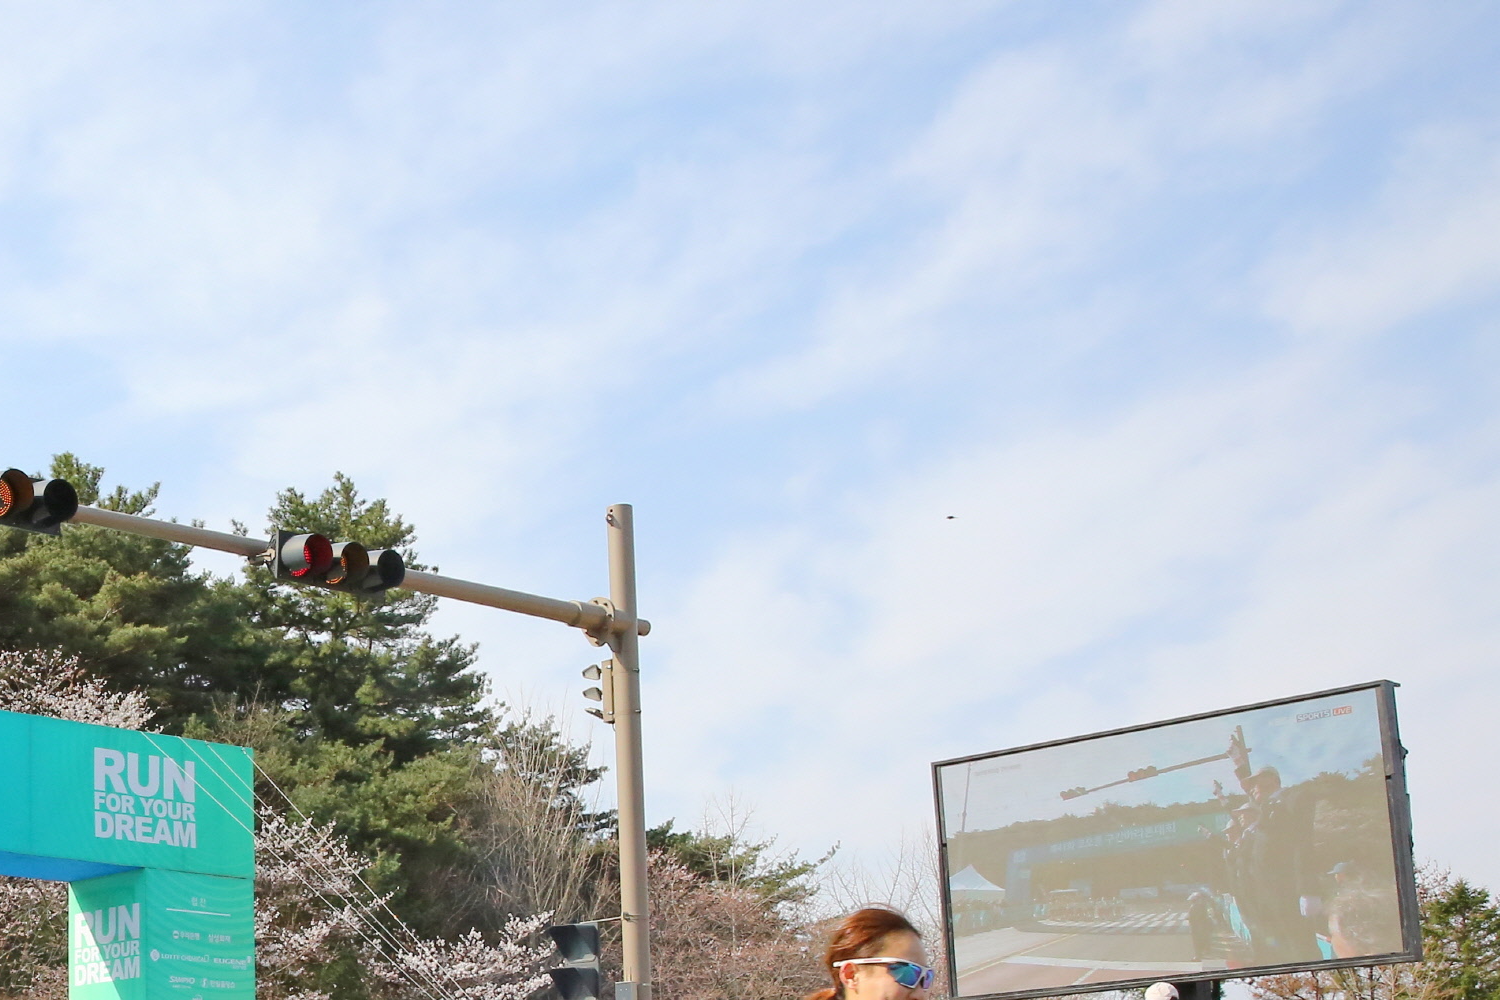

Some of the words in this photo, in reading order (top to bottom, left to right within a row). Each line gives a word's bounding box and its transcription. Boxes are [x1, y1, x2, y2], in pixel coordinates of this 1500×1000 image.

[1297, 710, 1330, 721] SPORTS
[1333, 706, 1352, 715] LIVE
[93, 746, 196, 803] RUN
[94, 791, 136, 815] FOR
[139, 797, 196, 822] YOUR
[94, 810, 197, 849] DREAM
[74, 902, 140, 950] RUN
[74, 947, 100, 966] FOR
[103, 940, 140, 960] YOUR
[74, 956, 140, 986] DREAM
